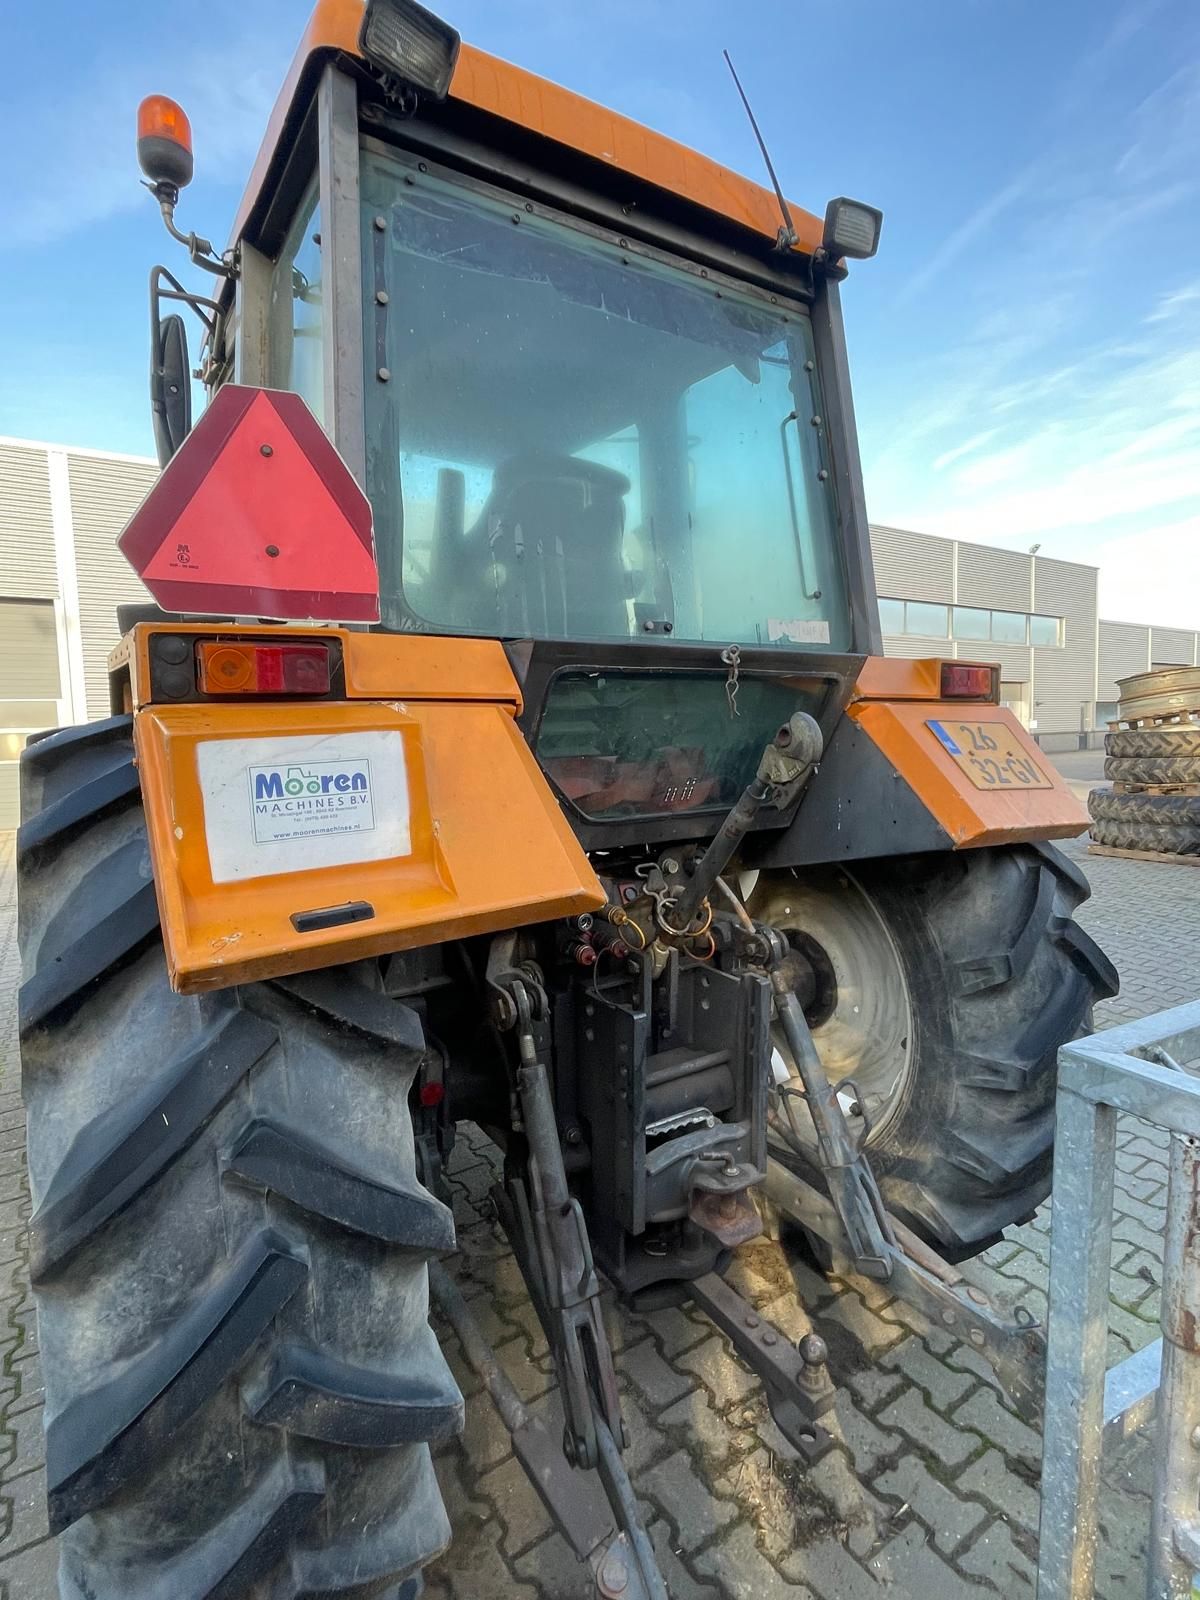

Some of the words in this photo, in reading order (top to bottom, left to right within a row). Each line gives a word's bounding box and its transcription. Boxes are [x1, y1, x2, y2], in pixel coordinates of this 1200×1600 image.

[959, 725, 998, 751] 26
[970, 758, 1041, 784] 32-GV
[255, 772, 368, 800] Mooren
[256, 798, 345, 814] MACHINES
[350, 794, 369, 805] B.V.
